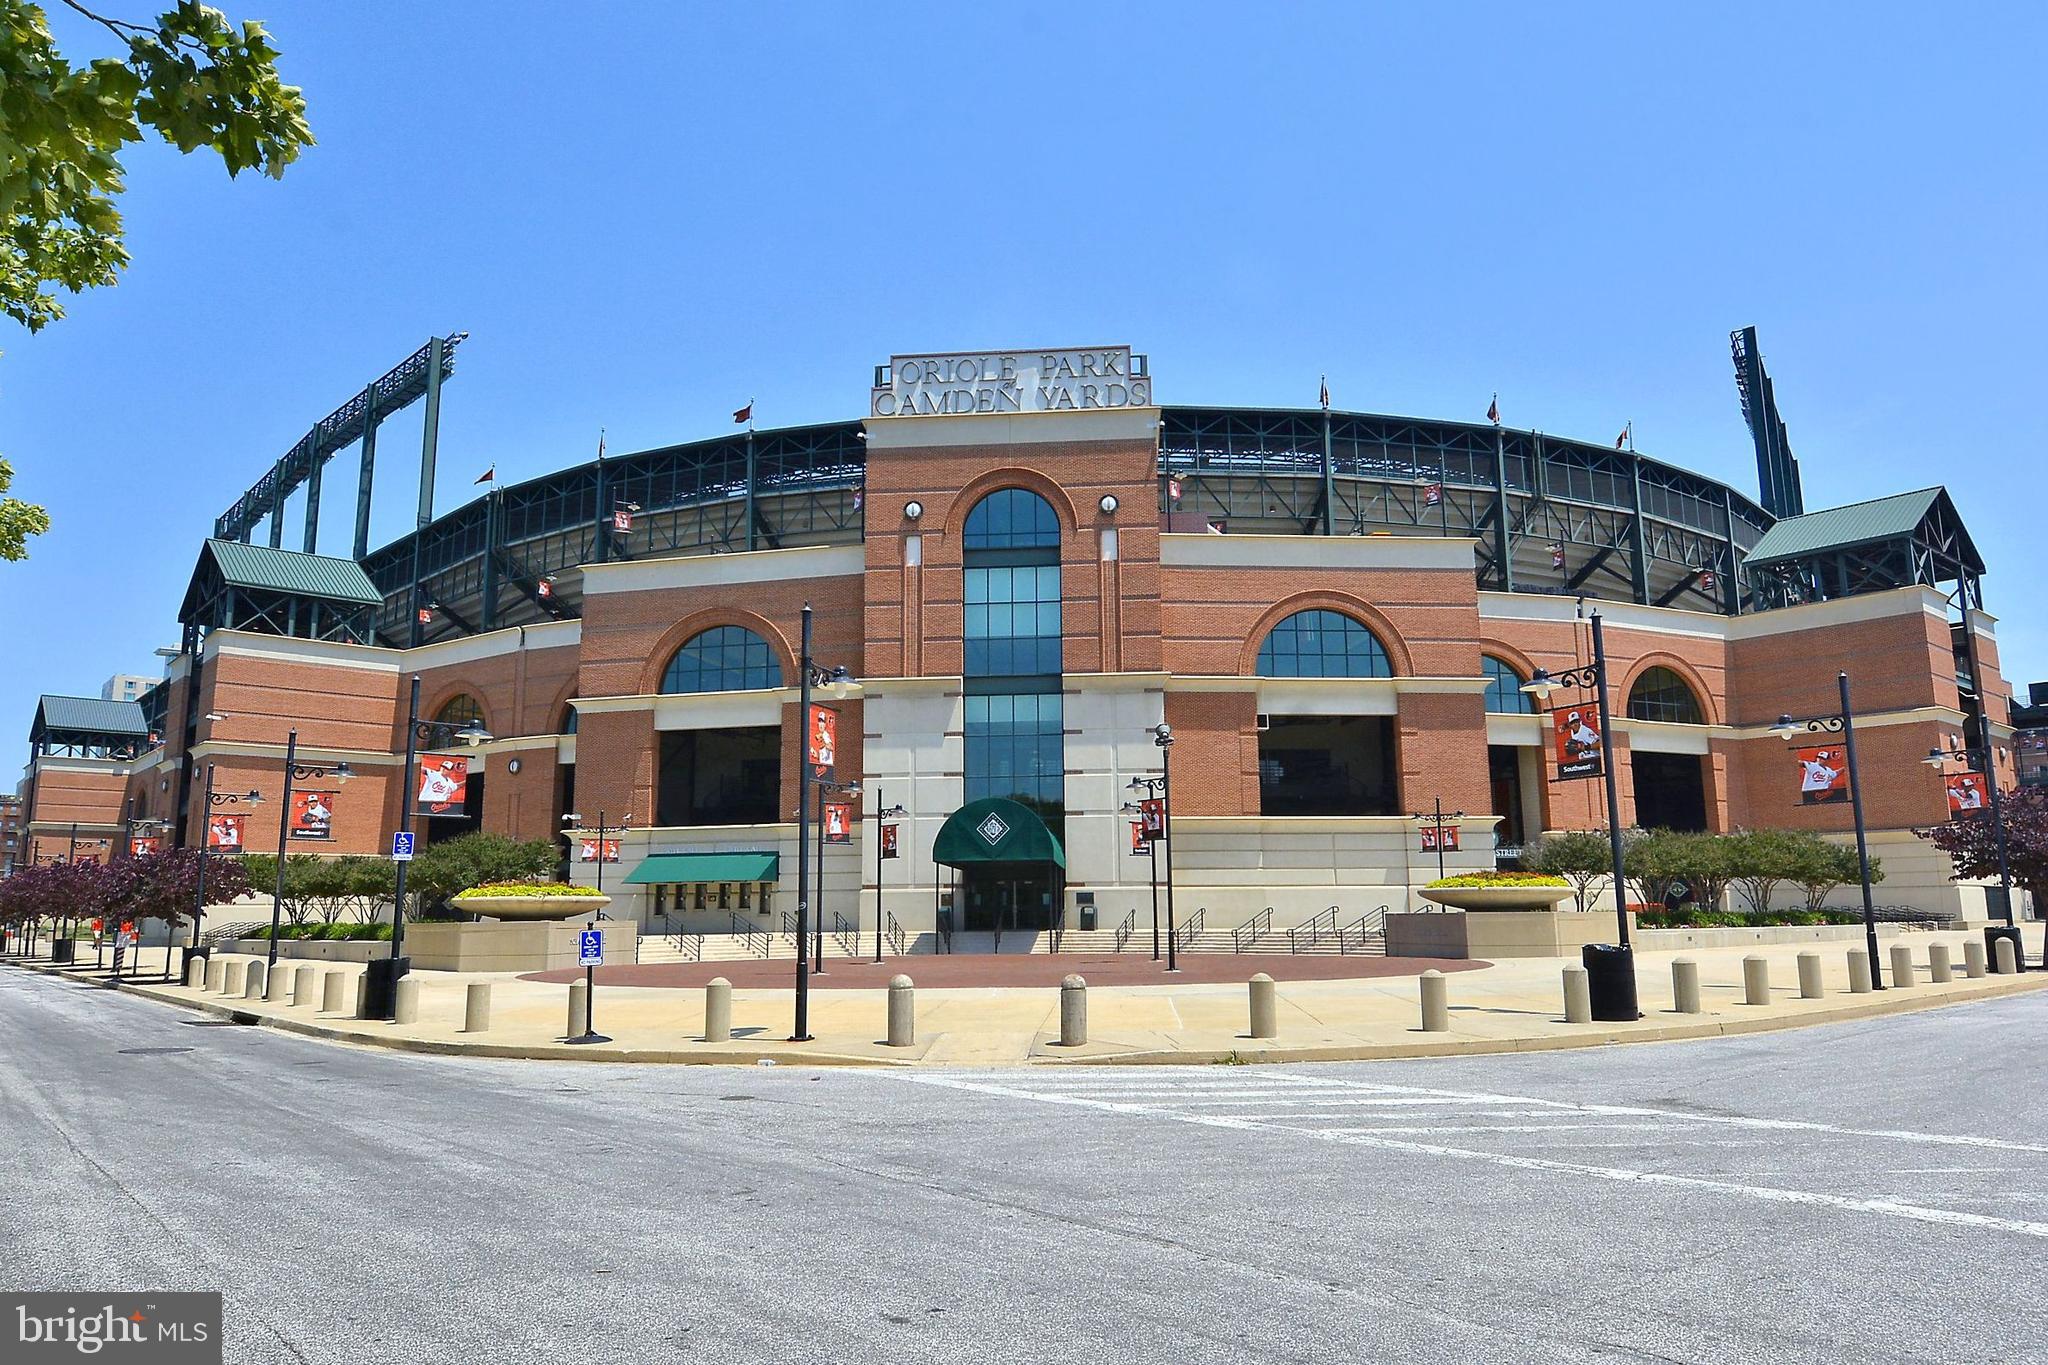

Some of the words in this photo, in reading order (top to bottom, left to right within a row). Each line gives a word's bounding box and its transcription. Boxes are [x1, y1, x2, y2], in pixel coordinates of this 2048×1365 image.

[900, 357, 1018, 384] ORIOLE
[1040, 352, 1125, 380] PARK
[1002, 380, 1017, 389] at
[875, 387, 1023, 416] CAMDEN
[1038, 383, 1147, 410] YARDS
[1496, 849, 1522, 857] STREET
